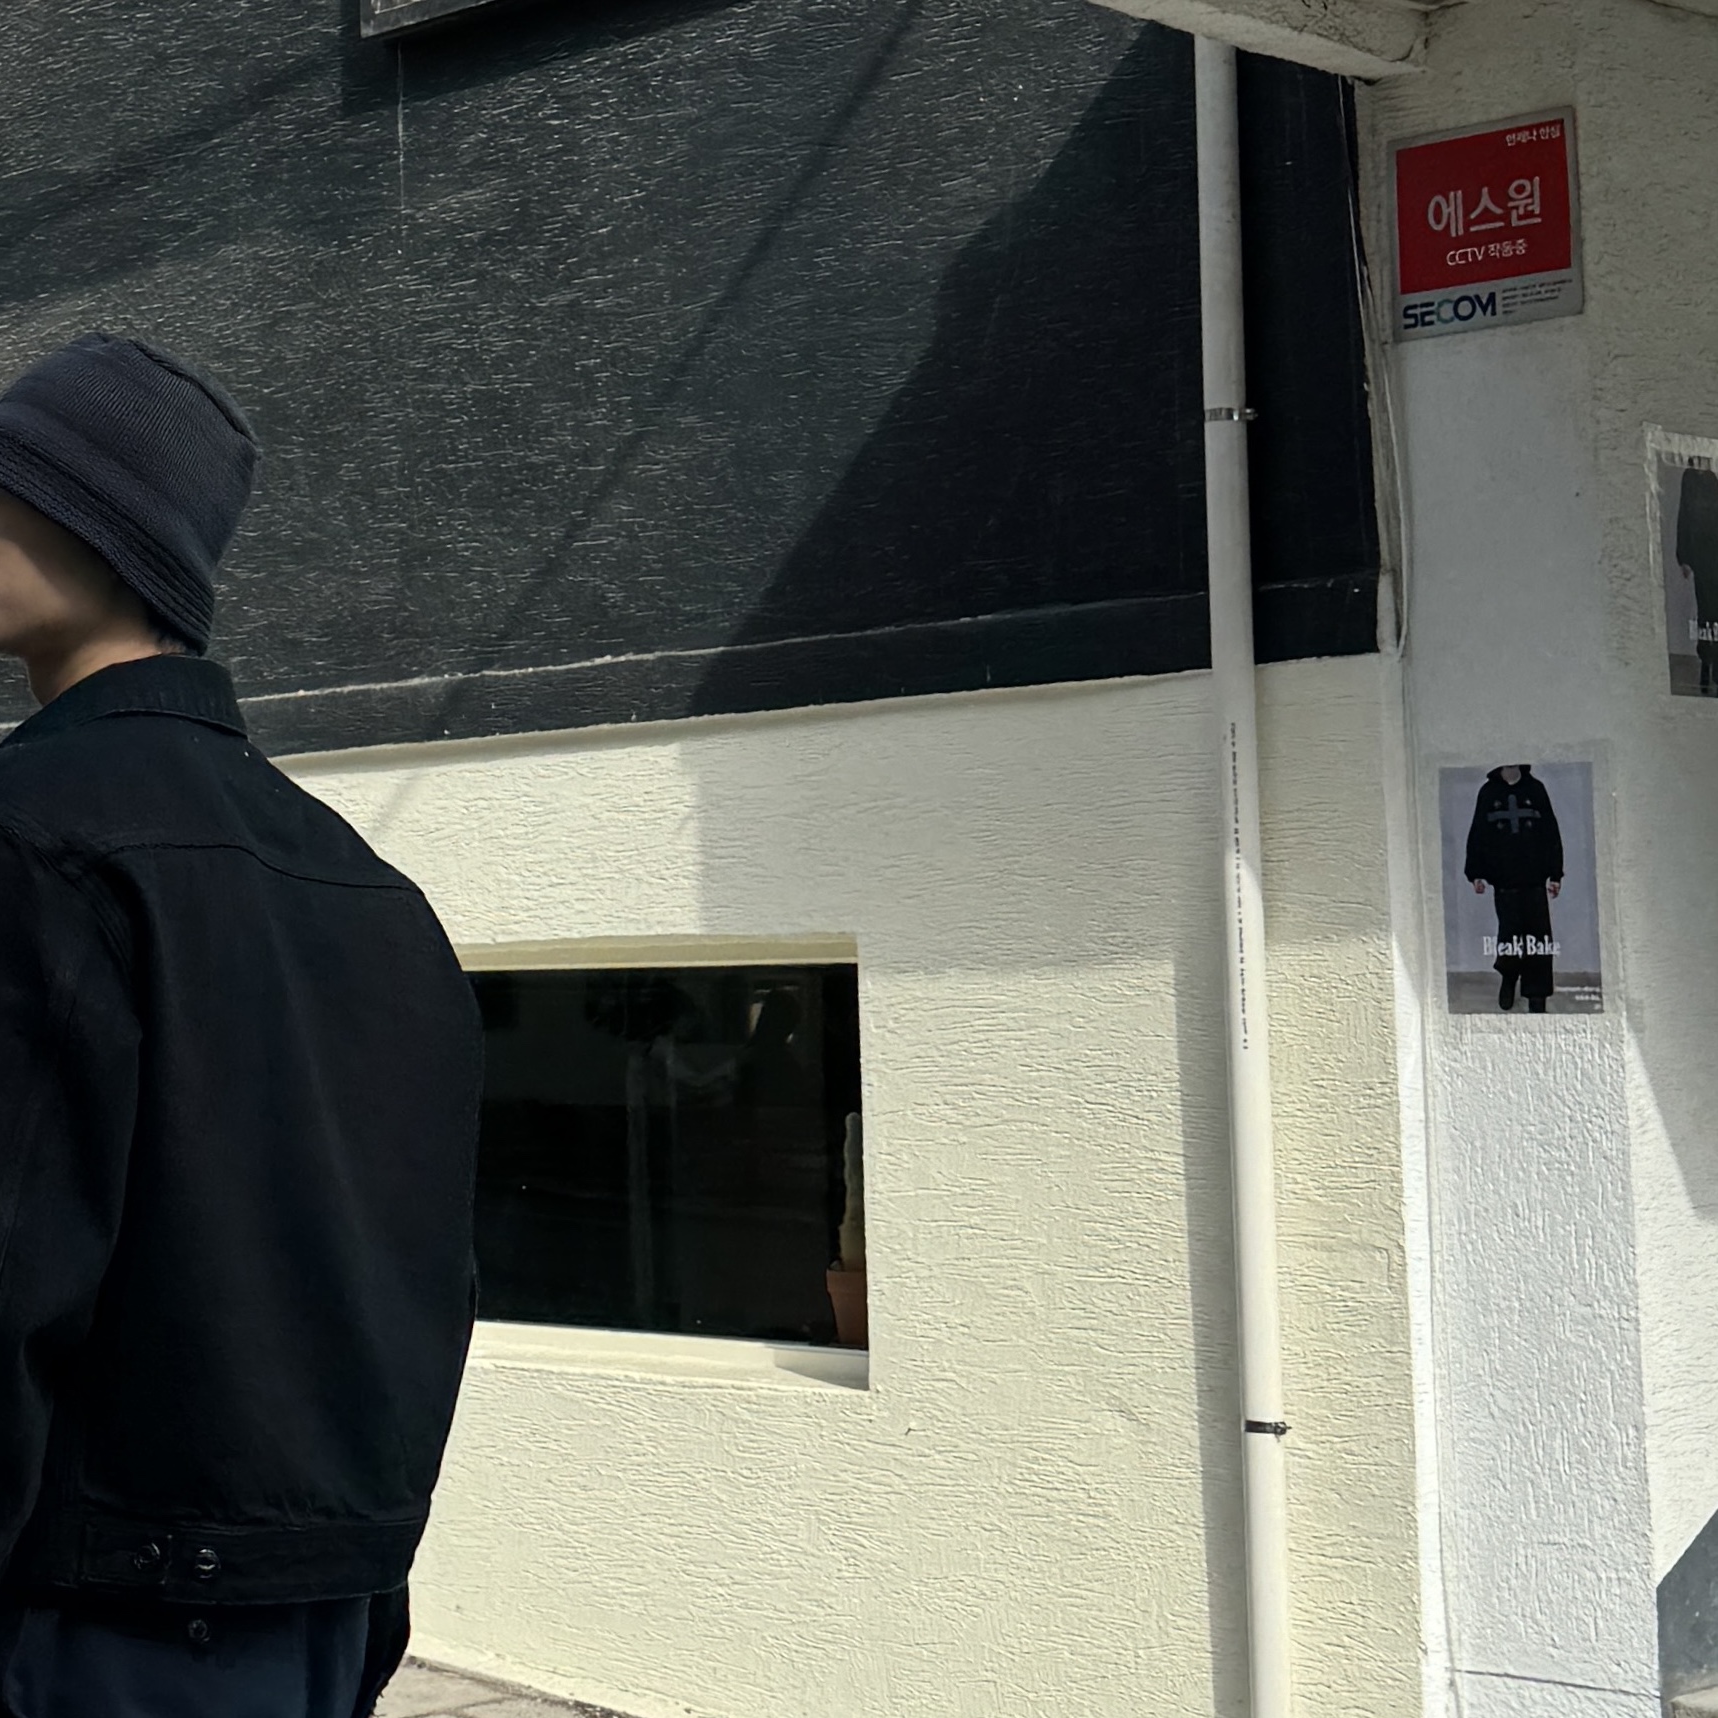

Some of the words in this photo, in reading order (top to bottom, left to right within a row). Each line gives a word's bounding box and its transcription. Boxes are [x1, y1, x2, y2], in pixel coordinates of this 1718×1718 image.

[1427, 176, 1542, 237] 에스원
[1446, 247, 1485, 266] CCTV
[1403, 292, 1497, 329] SECOM
[1525, 933, 1561, 957] Bake
